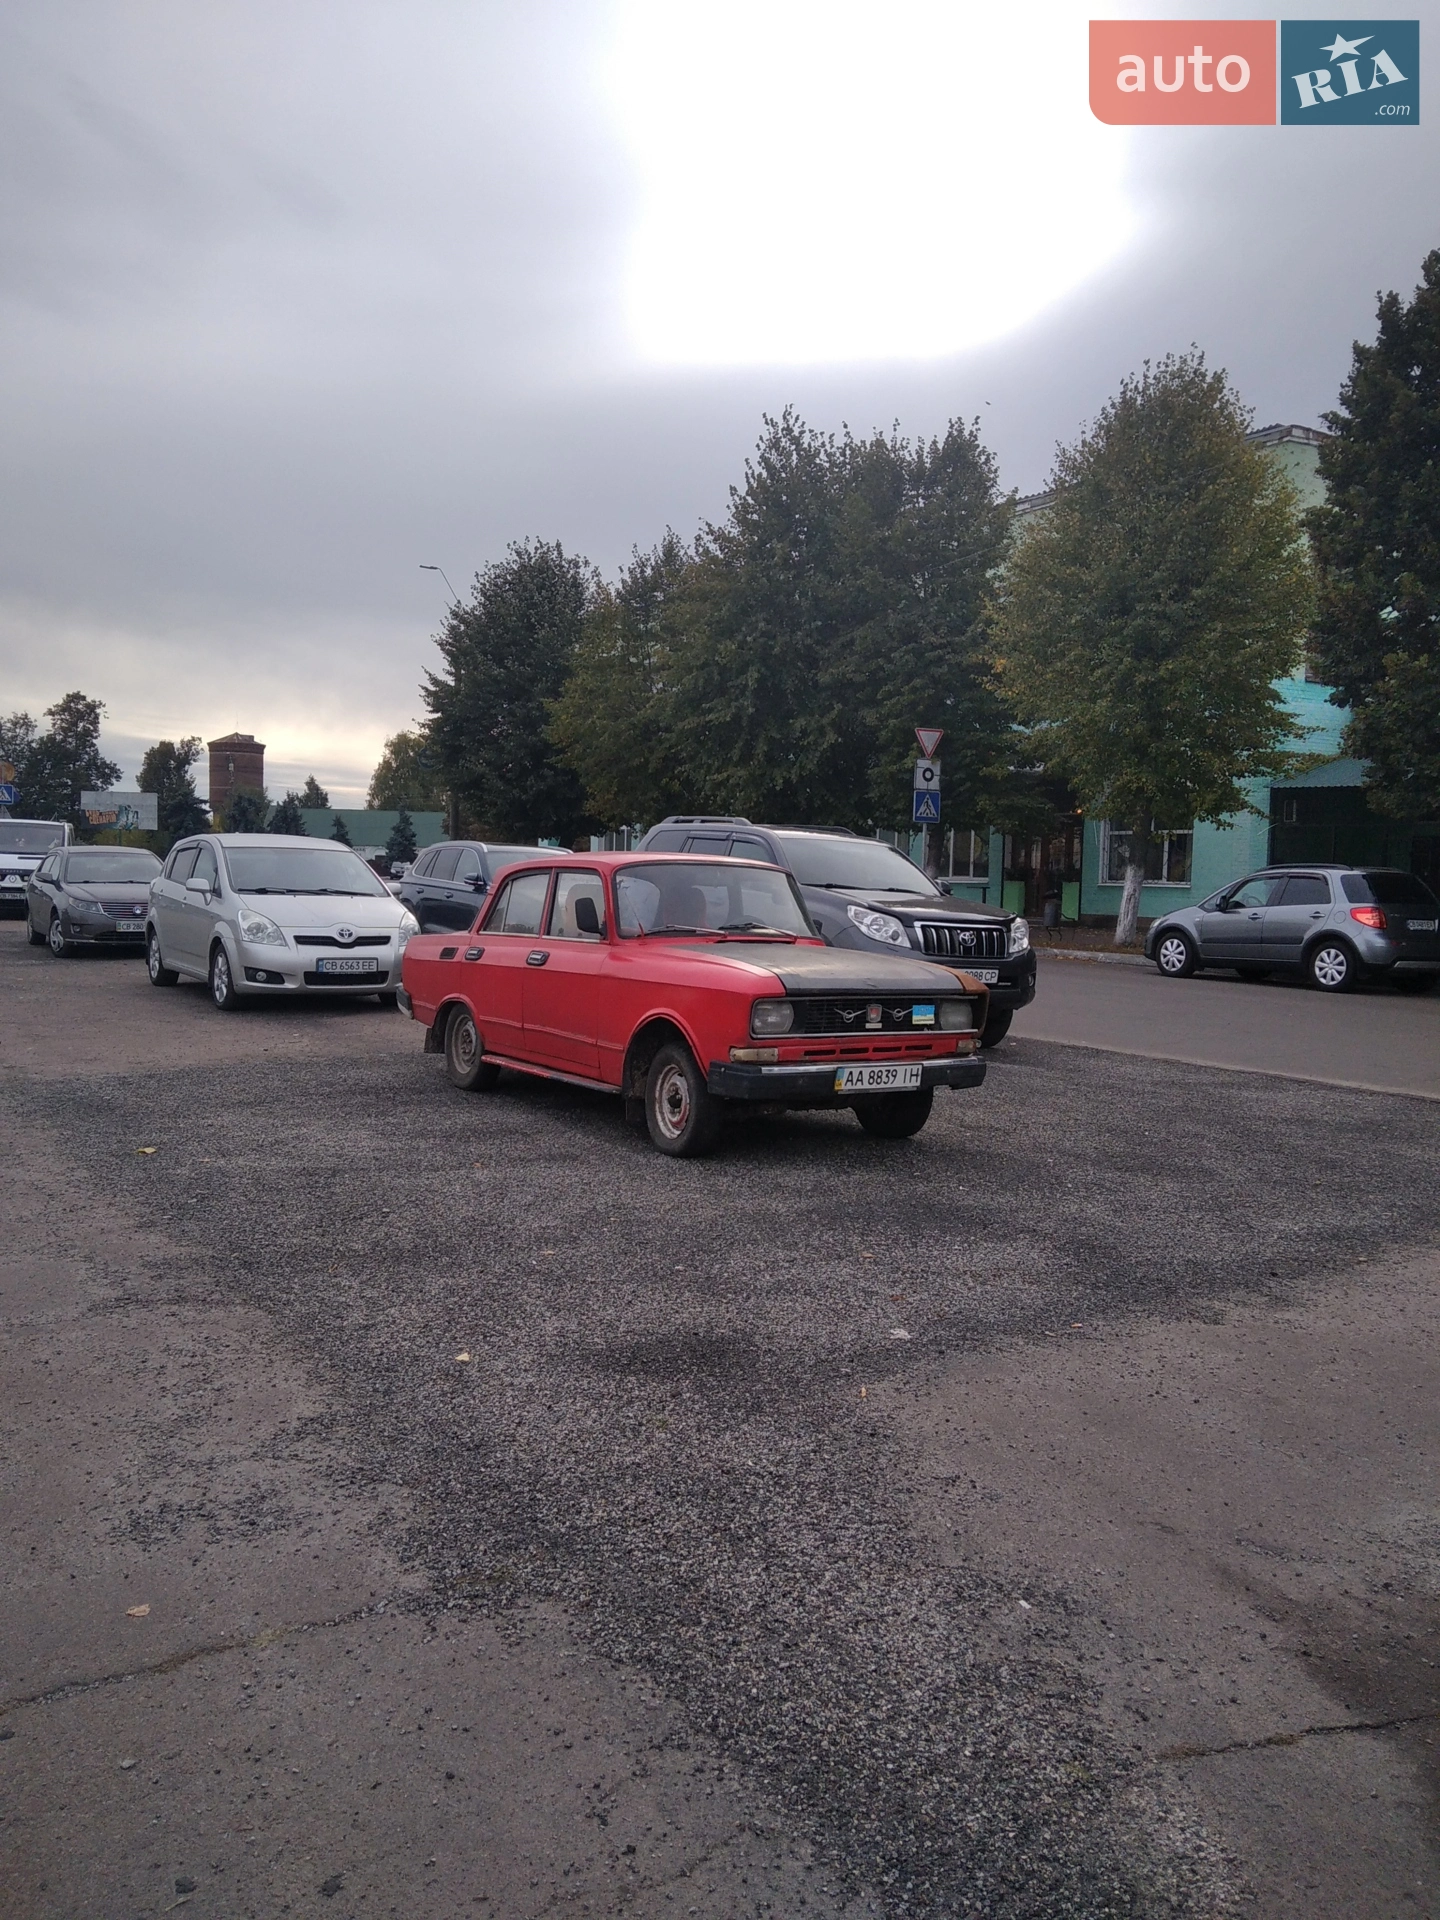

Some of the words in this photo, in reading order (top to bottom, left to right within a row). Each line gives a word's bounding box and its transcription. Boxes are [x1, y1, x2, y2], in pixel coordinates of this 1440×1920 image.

[324, 961, 338, 971] CB
[339, 961, 360, 971] 6563
[361, 961, 375, 971] EE
[984, 971, 997, 982] CP
[844, 1070, 864, 1086] AA
[867, 1069, 898, 1085] 8839
[903, 1067, 920, 1084] IH
